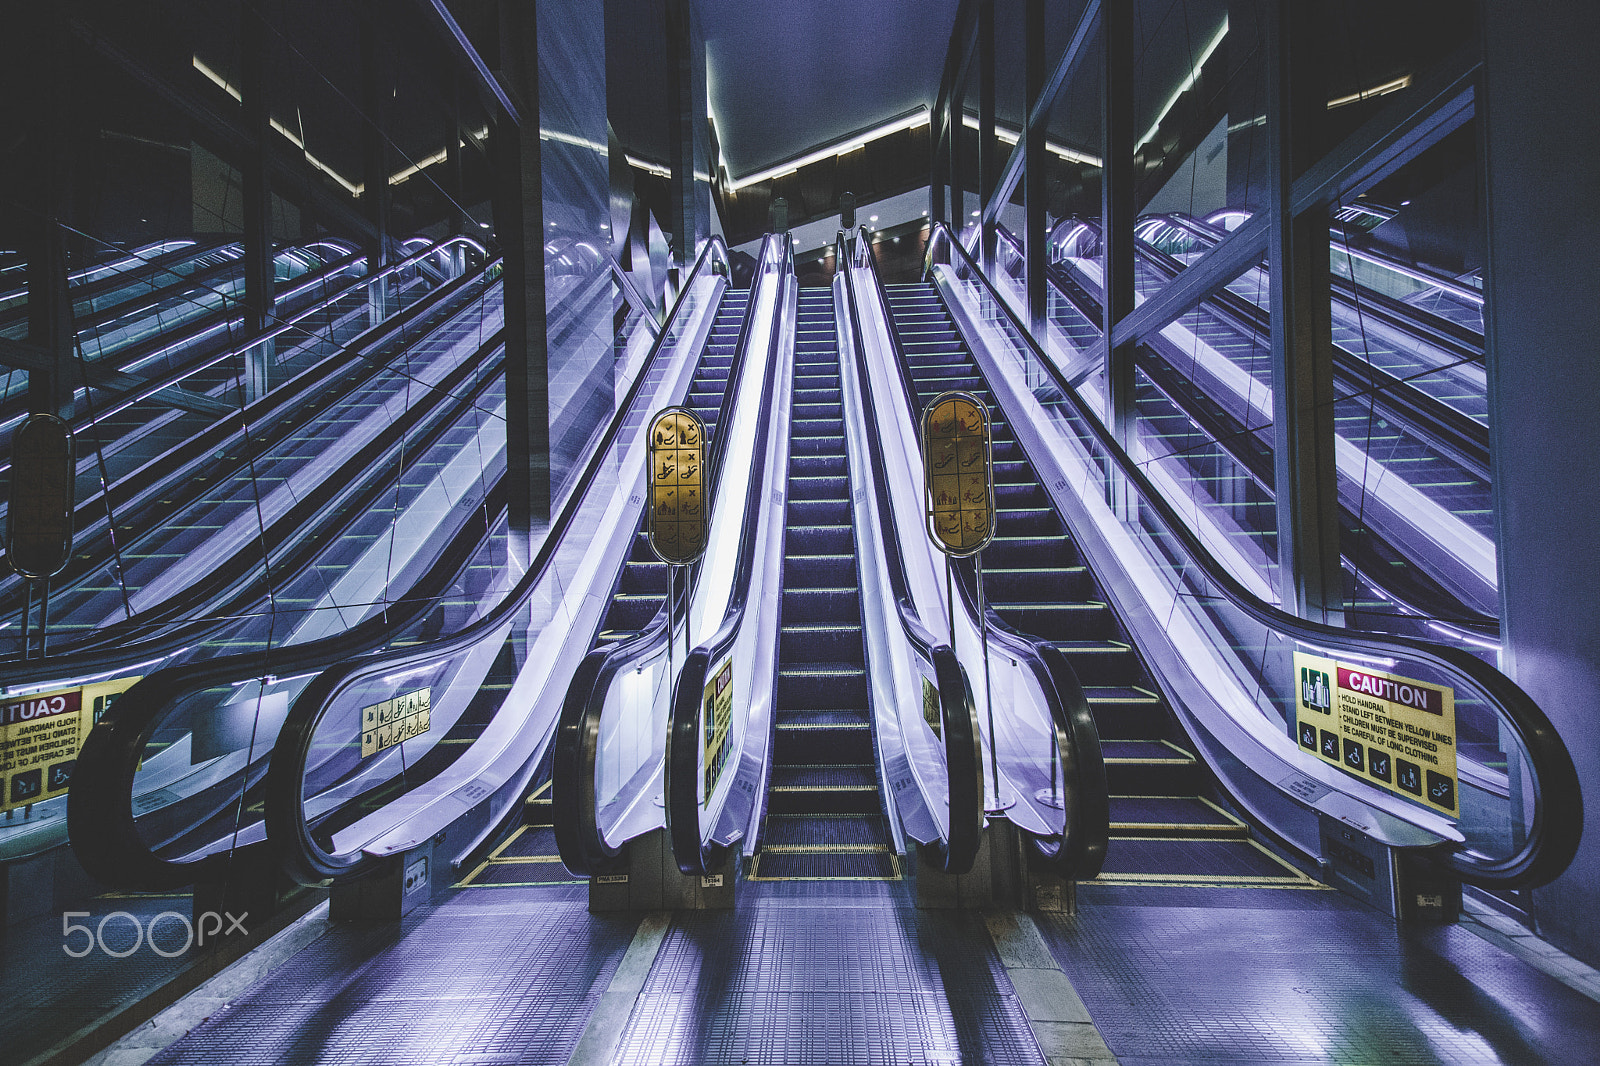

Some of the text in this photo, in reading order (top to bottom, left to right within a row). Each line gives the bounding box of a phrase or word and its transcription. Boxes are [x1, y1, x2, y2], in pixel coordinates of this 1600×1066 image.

[1342, 694, 1386, 713] HOLD HANDRAIL
[1349, 672, 1427, 709] CAUTION
[1342, 704, 1453, 746] STAND LEFT BETWEEN YELLOW LINES
[1343, 715, 1437, 752] CHILDREN MUST BE SUPERVISED
[1344, 725, 1438, 765] BE CAREFUL OF LONG CLOTHING
